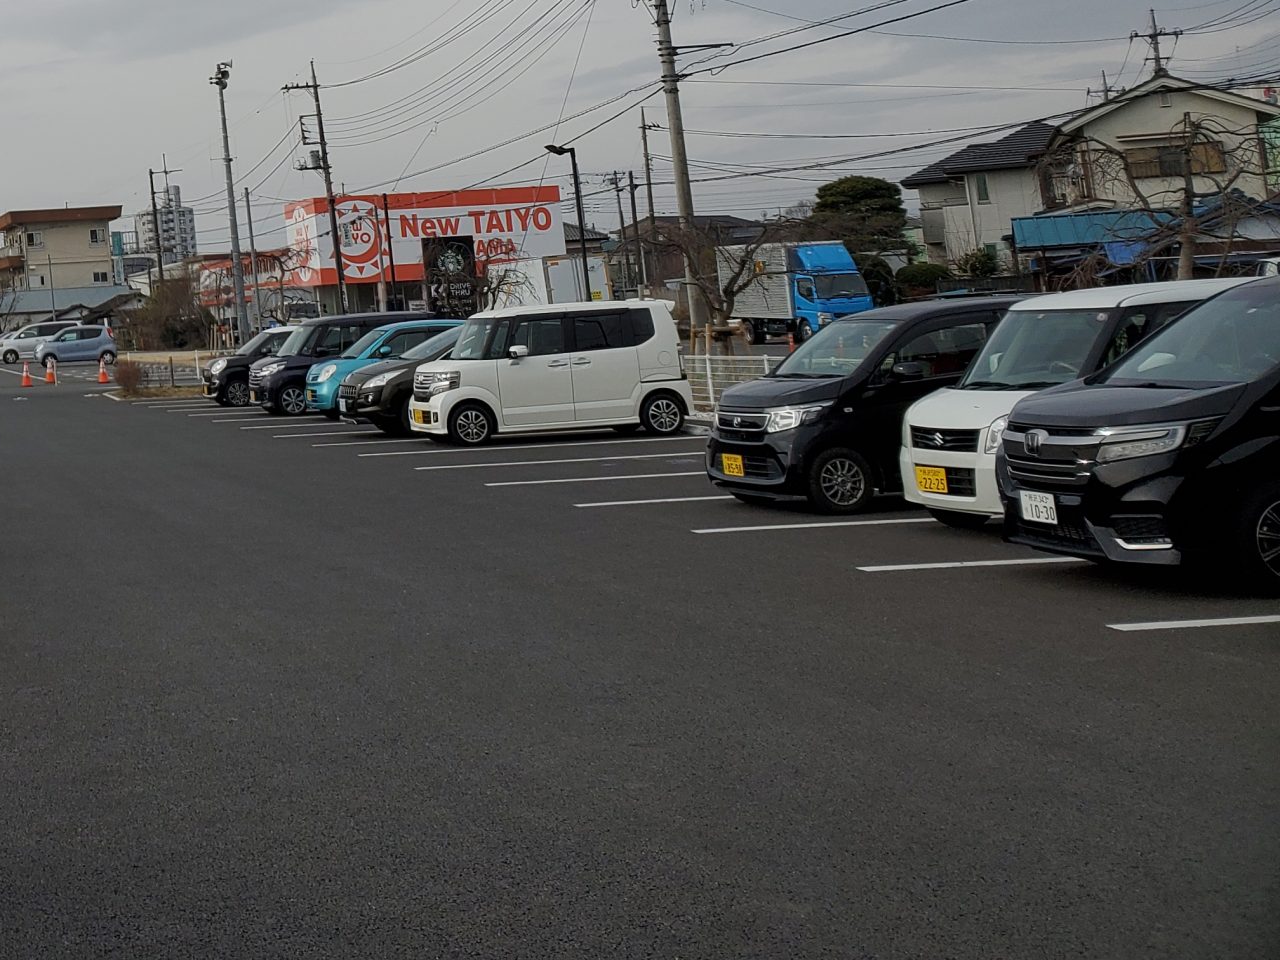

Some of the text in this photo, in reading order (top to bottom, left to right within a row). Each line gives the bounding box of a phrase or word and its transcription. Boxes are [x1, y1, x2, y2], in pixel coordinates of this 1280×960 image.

[400, 214, 460, 238] New
[468, 207, 552, 233] TAIYO
[449, 282, 472, 290] DRIVE
[922, 477, 946, 491] 22-25
[1030, 503, 1056, 521] 10-30
